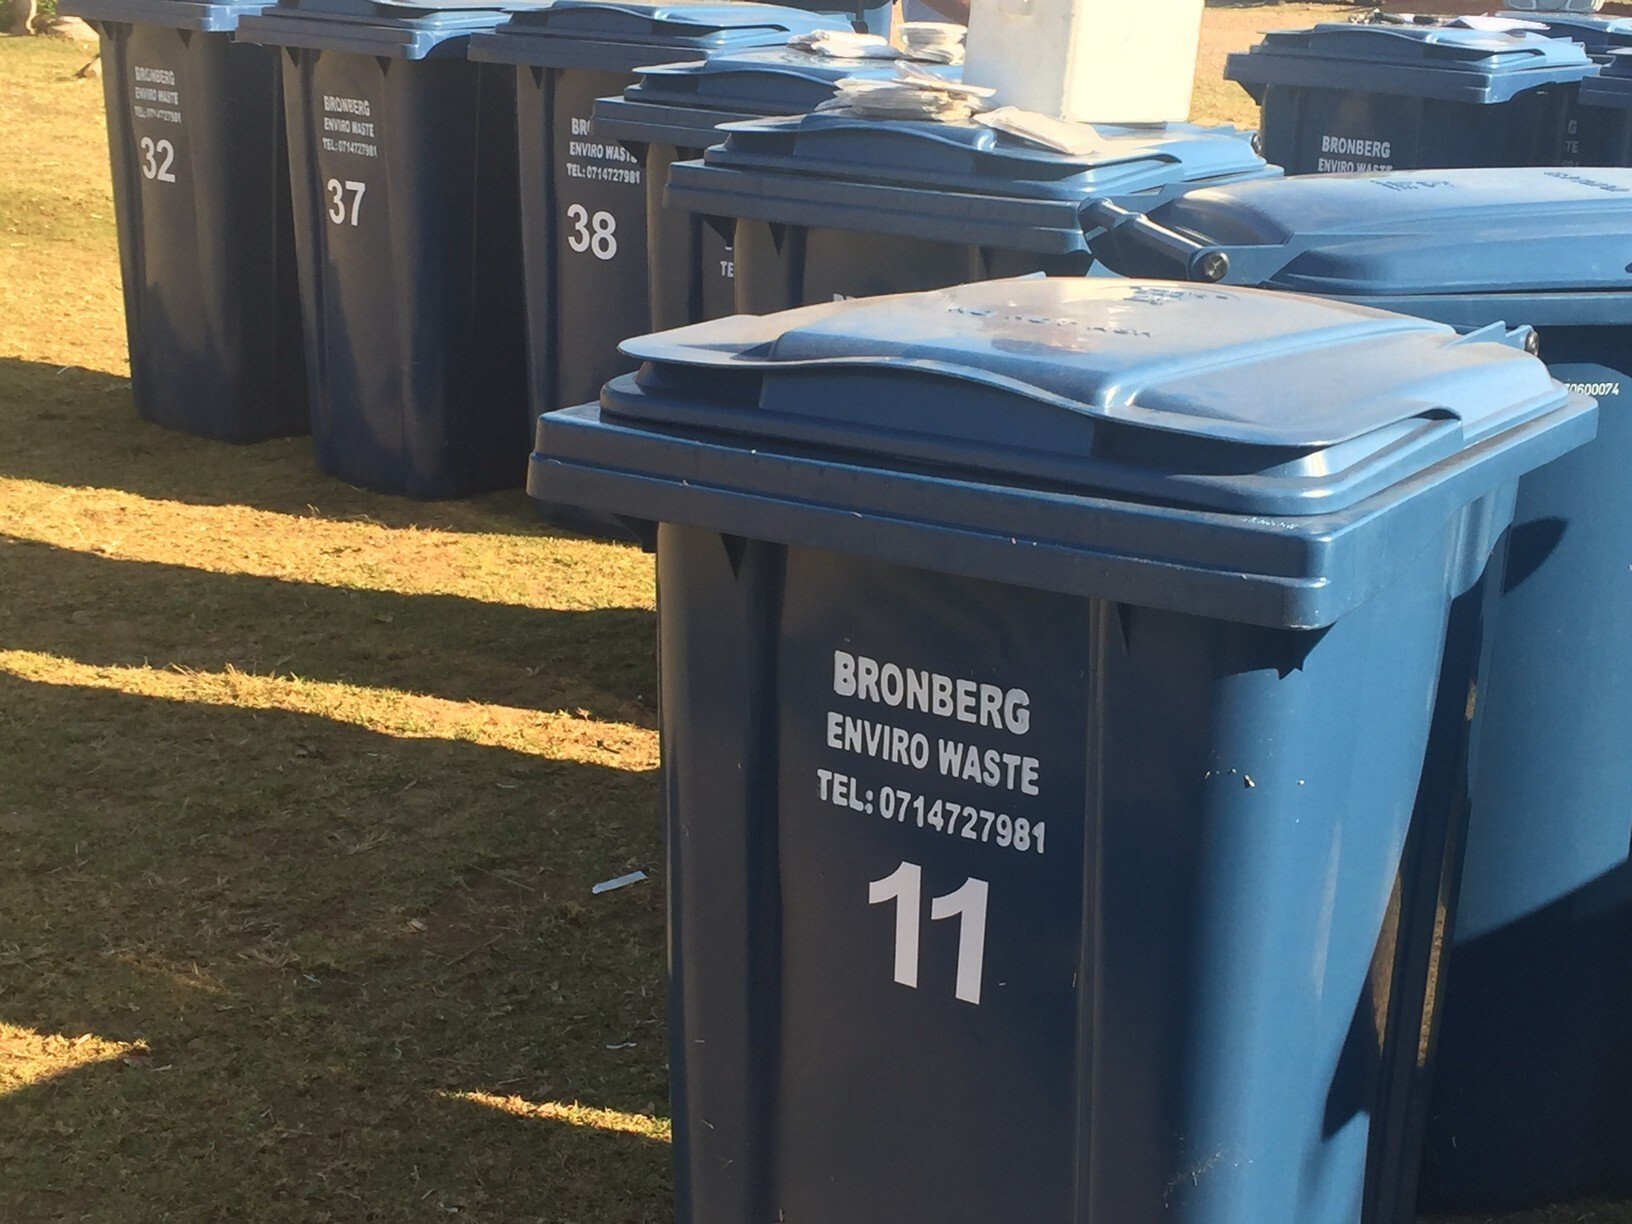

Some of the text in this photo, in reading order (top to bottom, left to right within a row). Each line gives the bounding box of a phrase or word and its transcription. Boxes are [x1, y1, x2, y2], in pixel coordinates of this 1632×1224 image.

[323, 95, 371, 117] BRONBERG
[140, 136, 176, 183] 32
[569, 141, 604, 159] ENVIRO
[1317, 157, 1355, 173] ENVIRO
[1321, 135, 1391, 159] BRONBERG
[327, 178, 366, 226] 37
[566, 203, 617, 260] 38
[833, 650, 1031, 735] BRONBERG
[826, 711, 1040, 795] ENVIRO WASTE
[868, 860, 989, 1005] 11
